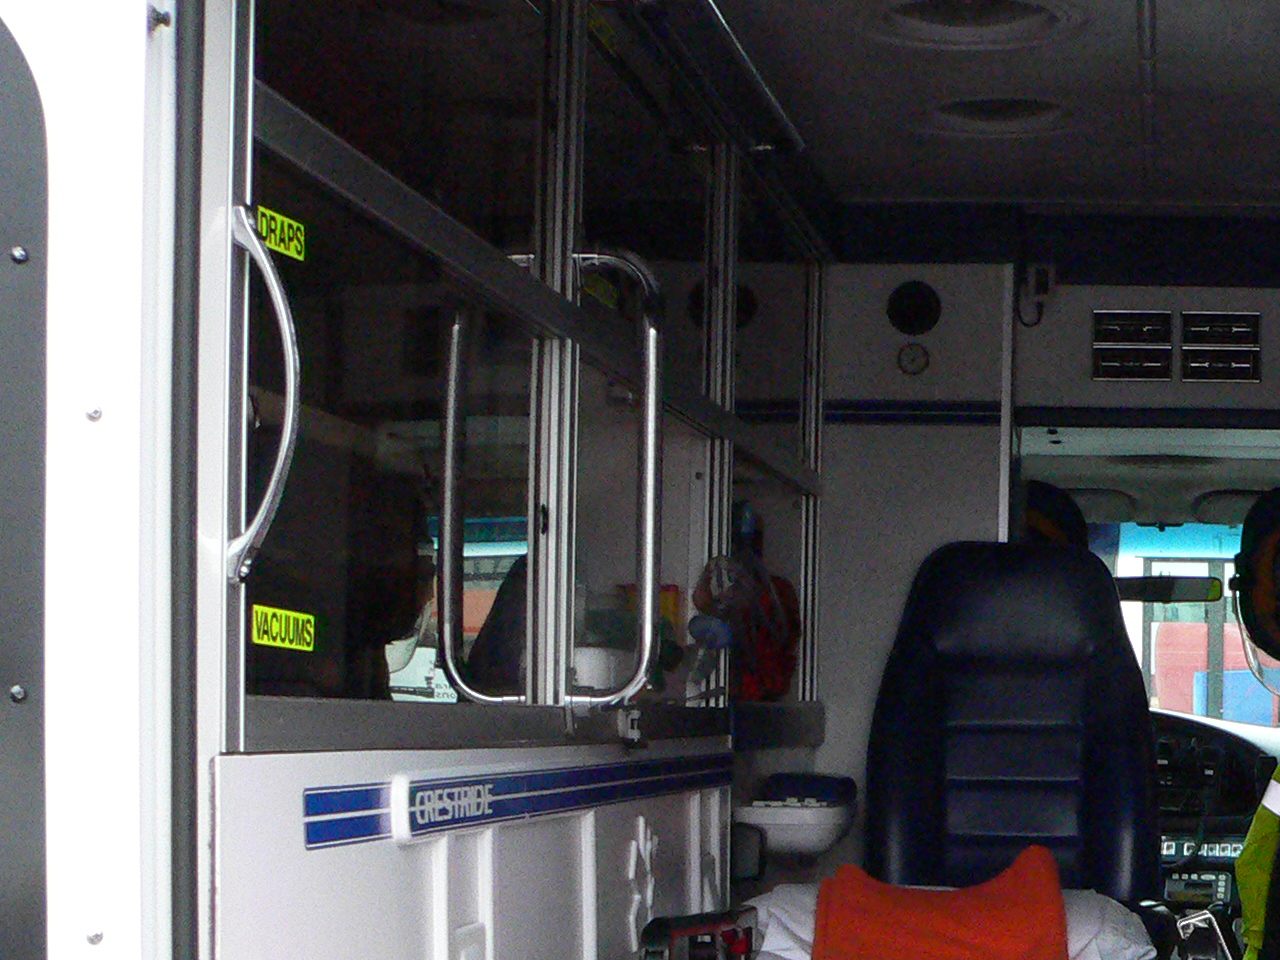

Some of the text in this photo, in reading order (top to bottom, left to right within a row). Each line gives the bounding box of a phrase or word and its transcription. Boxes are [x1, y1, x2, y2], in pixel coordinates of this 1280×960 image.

[260, 211, 303, 256] DRAPS
[255, 610, 313, 647] VACUUMS
[415, 784, 494, 824] CRESTRIDE
